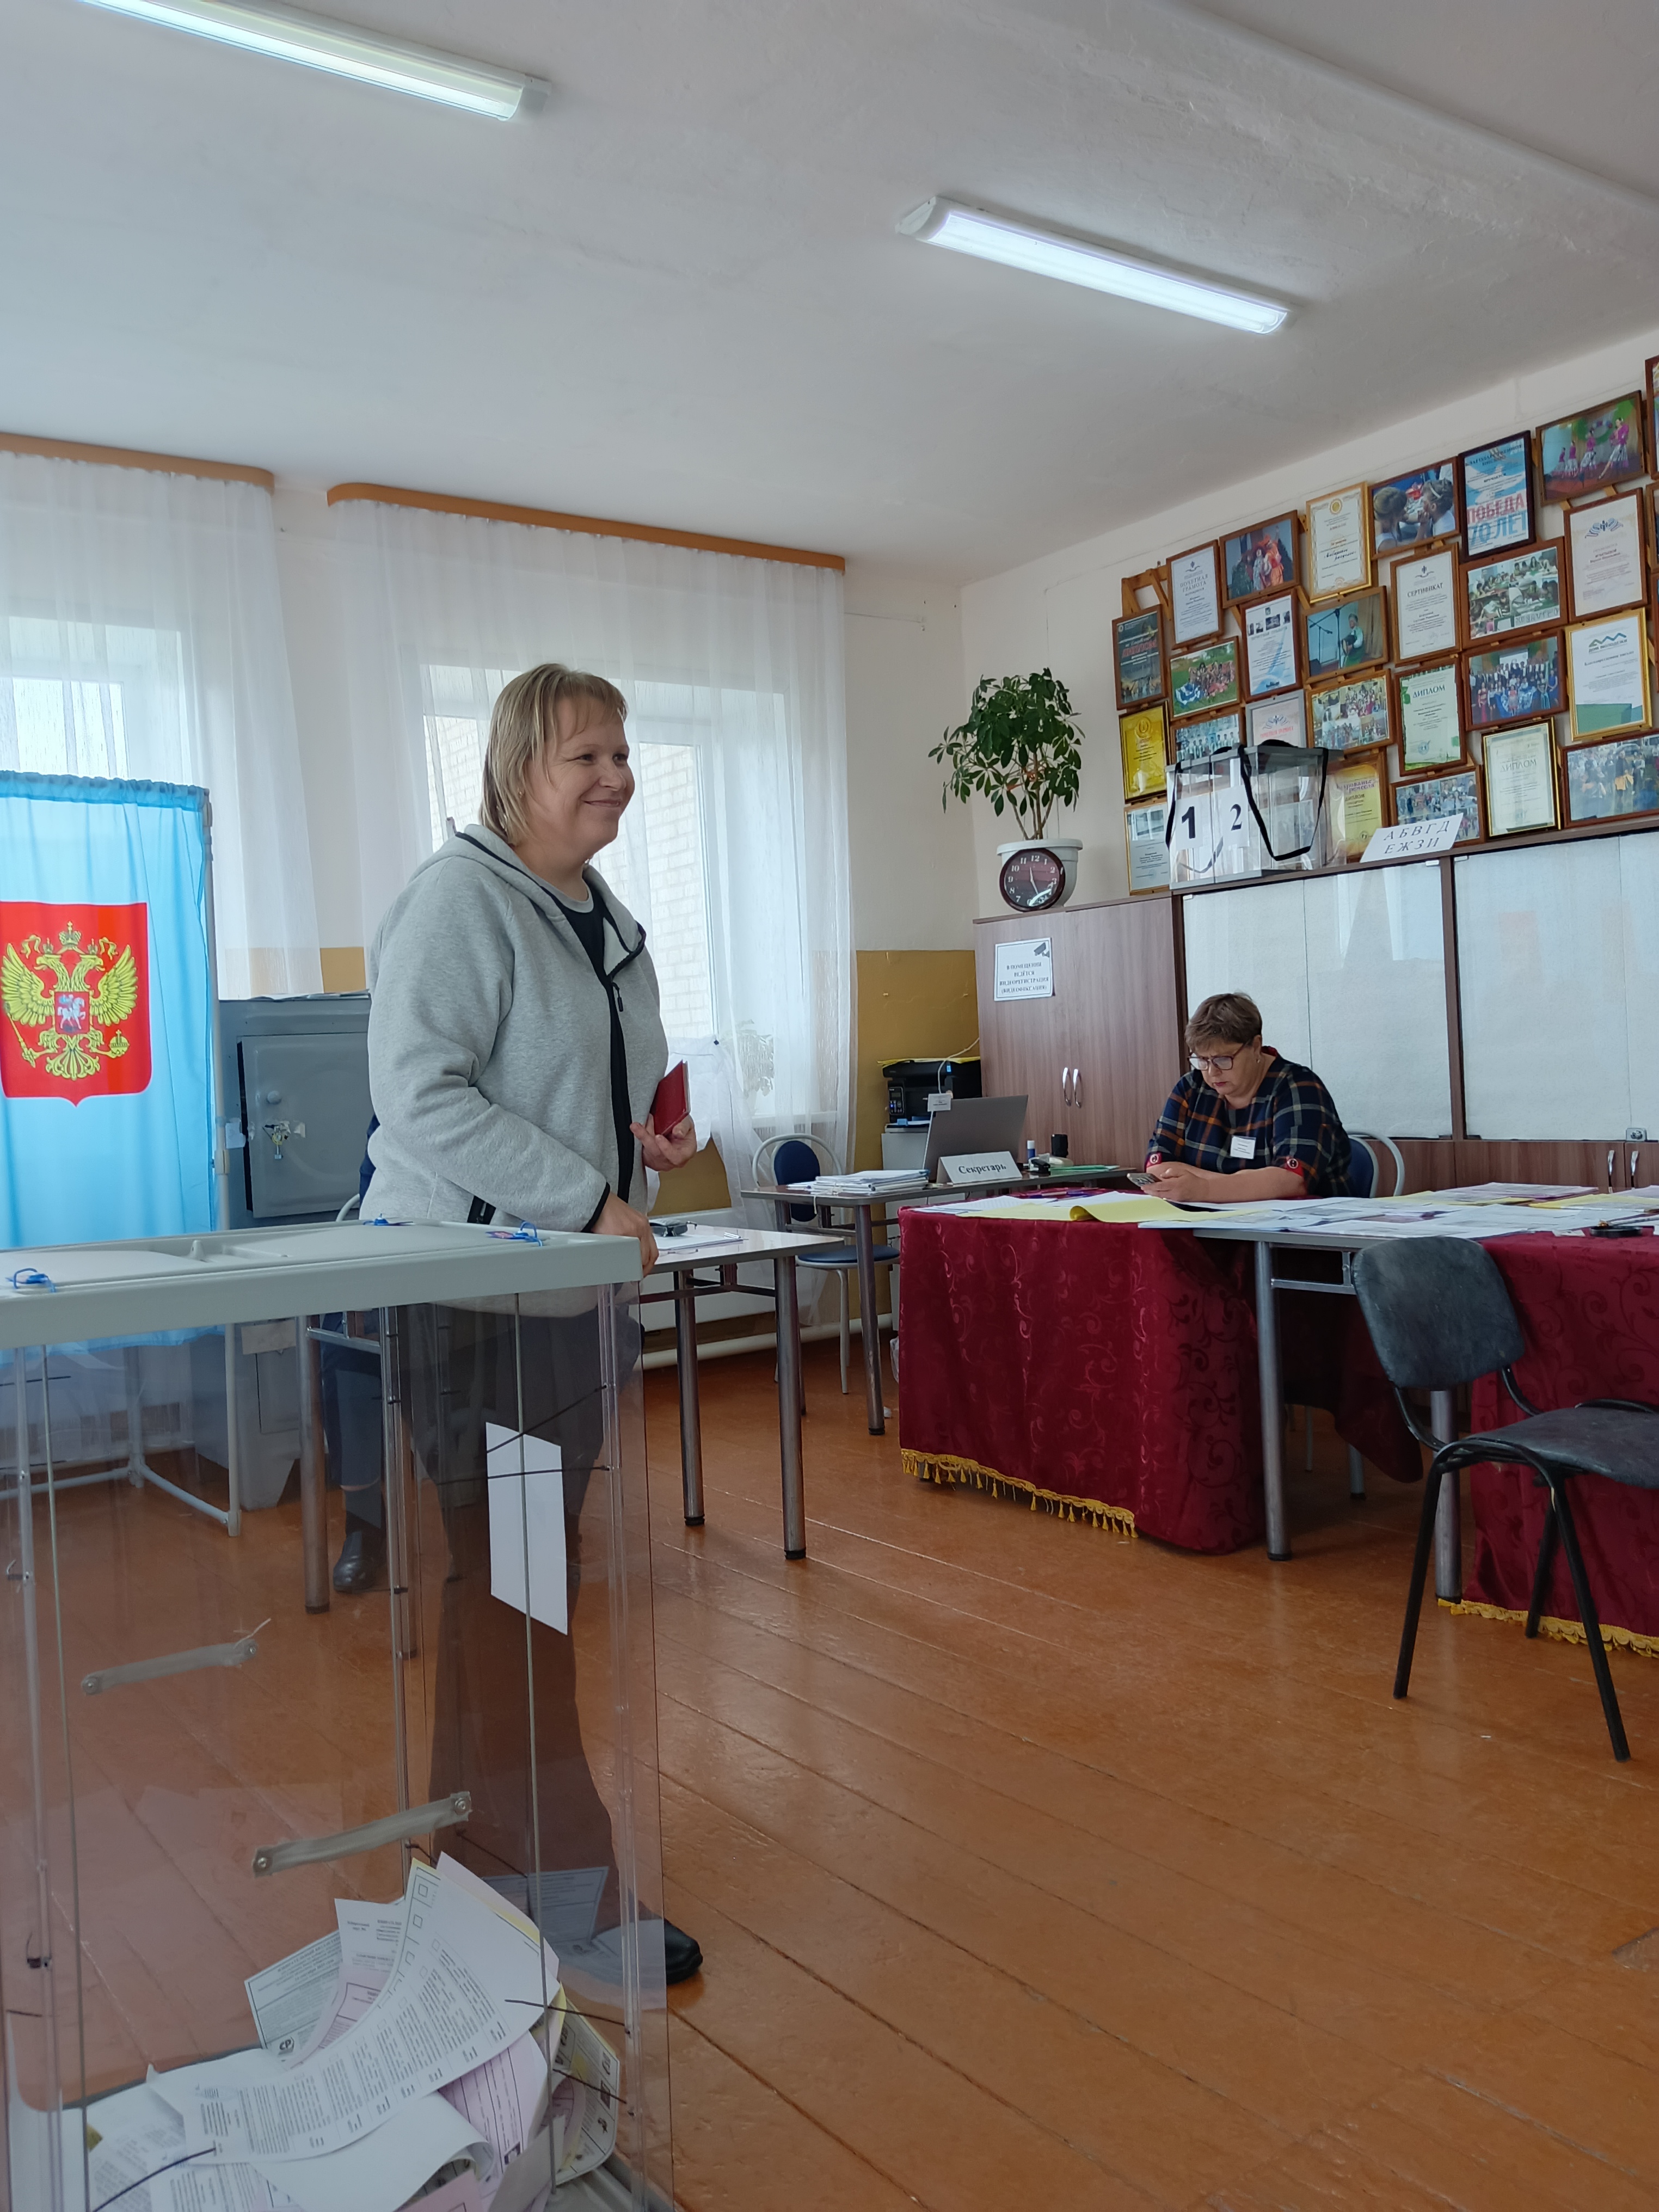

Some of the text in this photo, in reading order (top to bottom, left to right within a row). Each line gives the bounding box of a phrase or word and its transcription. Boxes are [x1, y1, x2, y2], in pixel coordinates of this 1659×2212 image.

[1467, 493, 1524, 525] ПОБЕДА
[1470, 512, 1526, 544] 70 ЛЕТ
[1407, 582, 1443, 598] СЕРТИФИКАТ
[1413, 684, 1445, 698] ДИПЛОМ
[1501, 758, 1537, 772] ДИПЛОМ
[1182, 806, 1196, 839] 1
[1230, 804, 1243, 831] 2
[999, 977, 1049, 986] ВИДЕОРЕГИСТРАЦИЯ
[958, 1163, 1006, 1174] Секретарь
